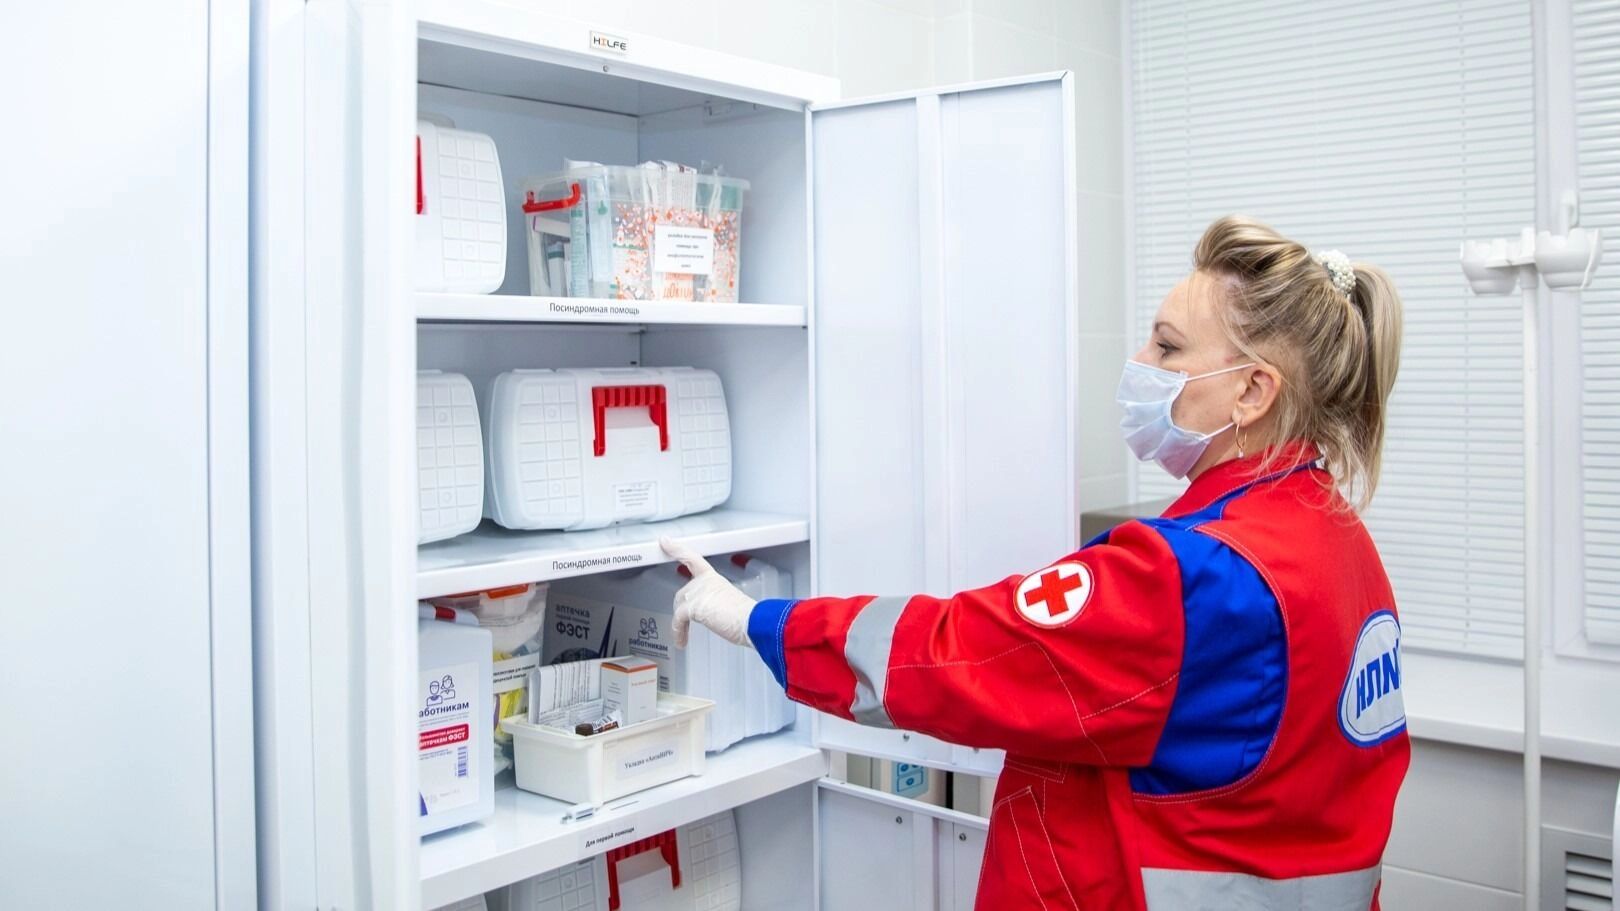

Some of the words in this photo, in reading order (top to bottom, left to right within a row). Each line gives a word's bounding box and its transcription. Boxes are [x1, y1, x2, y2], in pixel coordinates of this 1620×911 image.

[593, 35, 627, 51] HILFE
[549, 302, 608, 315] Посиндромная
[609, 306, 640, 315] помощь
[552, 557, 610, 571] Посиндромная
[612, 553, 643, 565] помощь
[556, 603, 591, 619] аптечка
[556, 621, 590, 640] ФЭСТ
[629, 638, 669, 652] работникам
[1356, 638, 1400, 720] НЛМ
[419, 701, 470, 719] аботникам
[448, 732, 466, 741] ФЭСТ
[585, 840, 595, 848] Для
